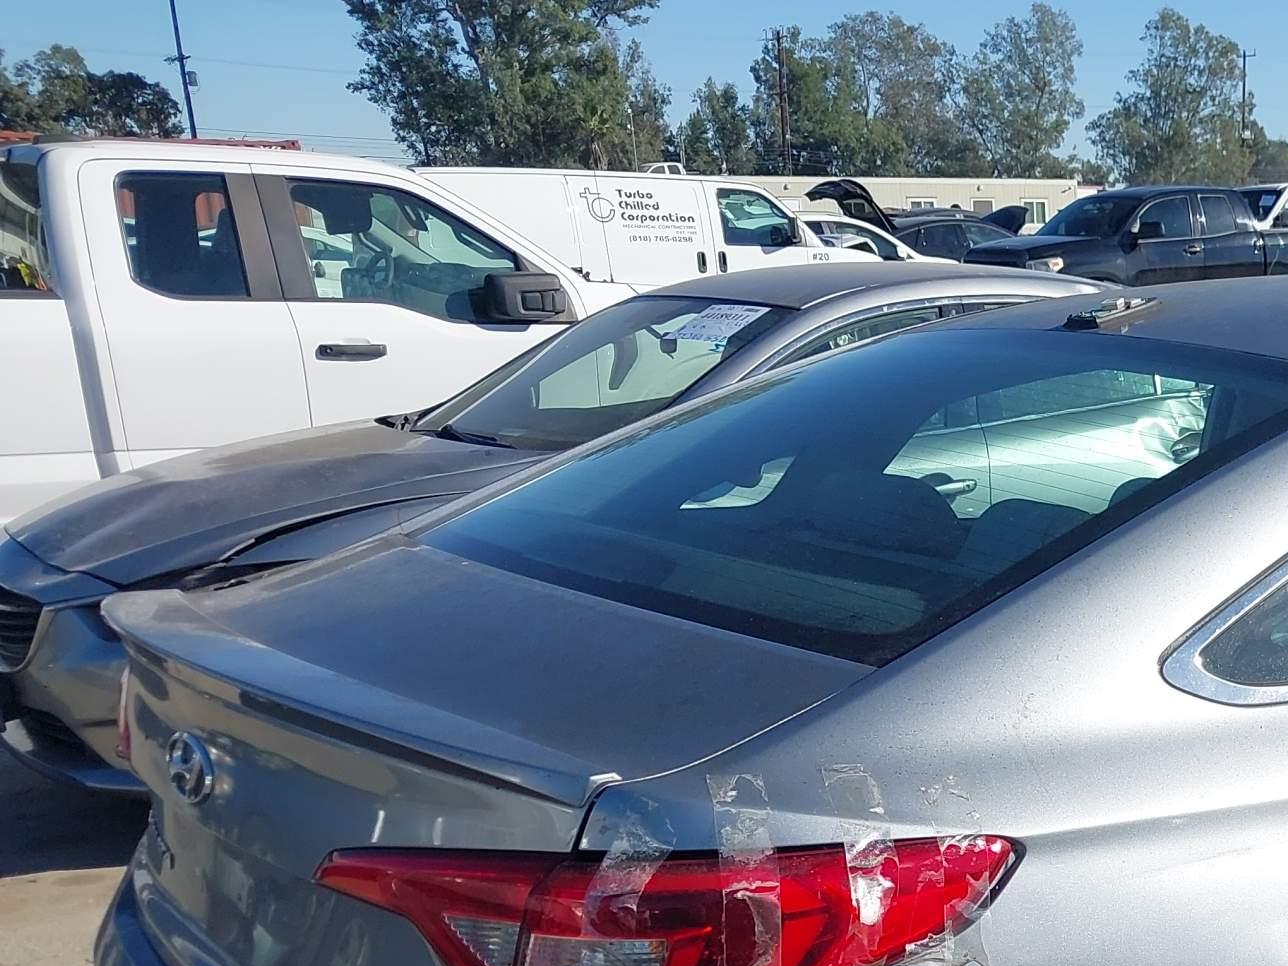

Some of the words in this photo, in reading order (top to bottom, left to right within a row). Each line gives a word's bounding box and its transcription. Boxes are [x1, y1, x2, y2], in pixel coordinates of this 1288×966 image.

[615, 188, 654, 199] Turbo
[618, 200, 660, 211] Chilled
[620, 211, 696, 224] Corporation
[629, 235, 652, 243] (818)
[812, 253, 830, 261] #20
